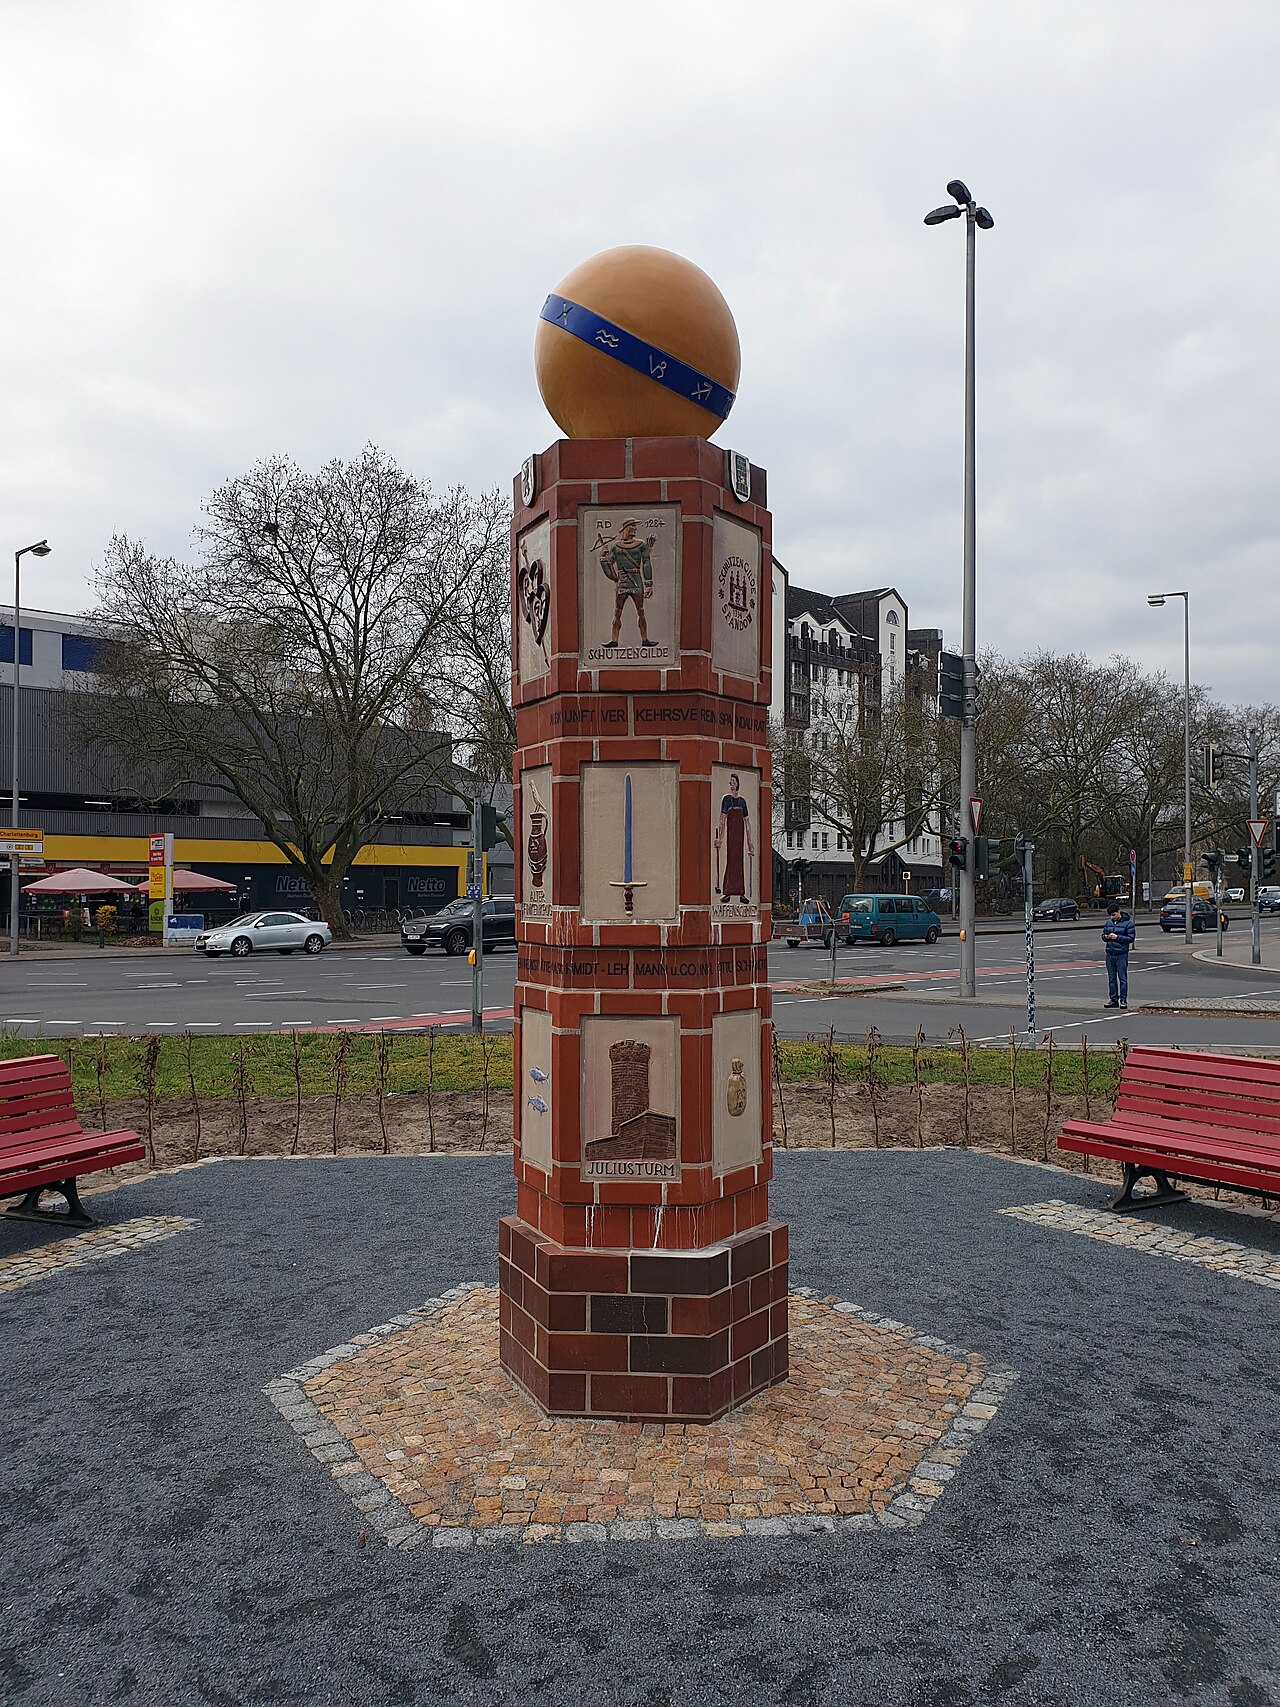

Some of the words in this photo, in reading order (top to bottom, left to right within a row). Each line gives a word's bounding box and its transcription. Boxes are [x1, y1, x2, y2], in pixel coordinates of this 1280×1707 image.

[596, 520, 612, 529] AD
[276, 875, 311, 893] Nett
[407, 876, 446, 893] Netto
[587, 1161, 676, 1177] JULIUSTURM
